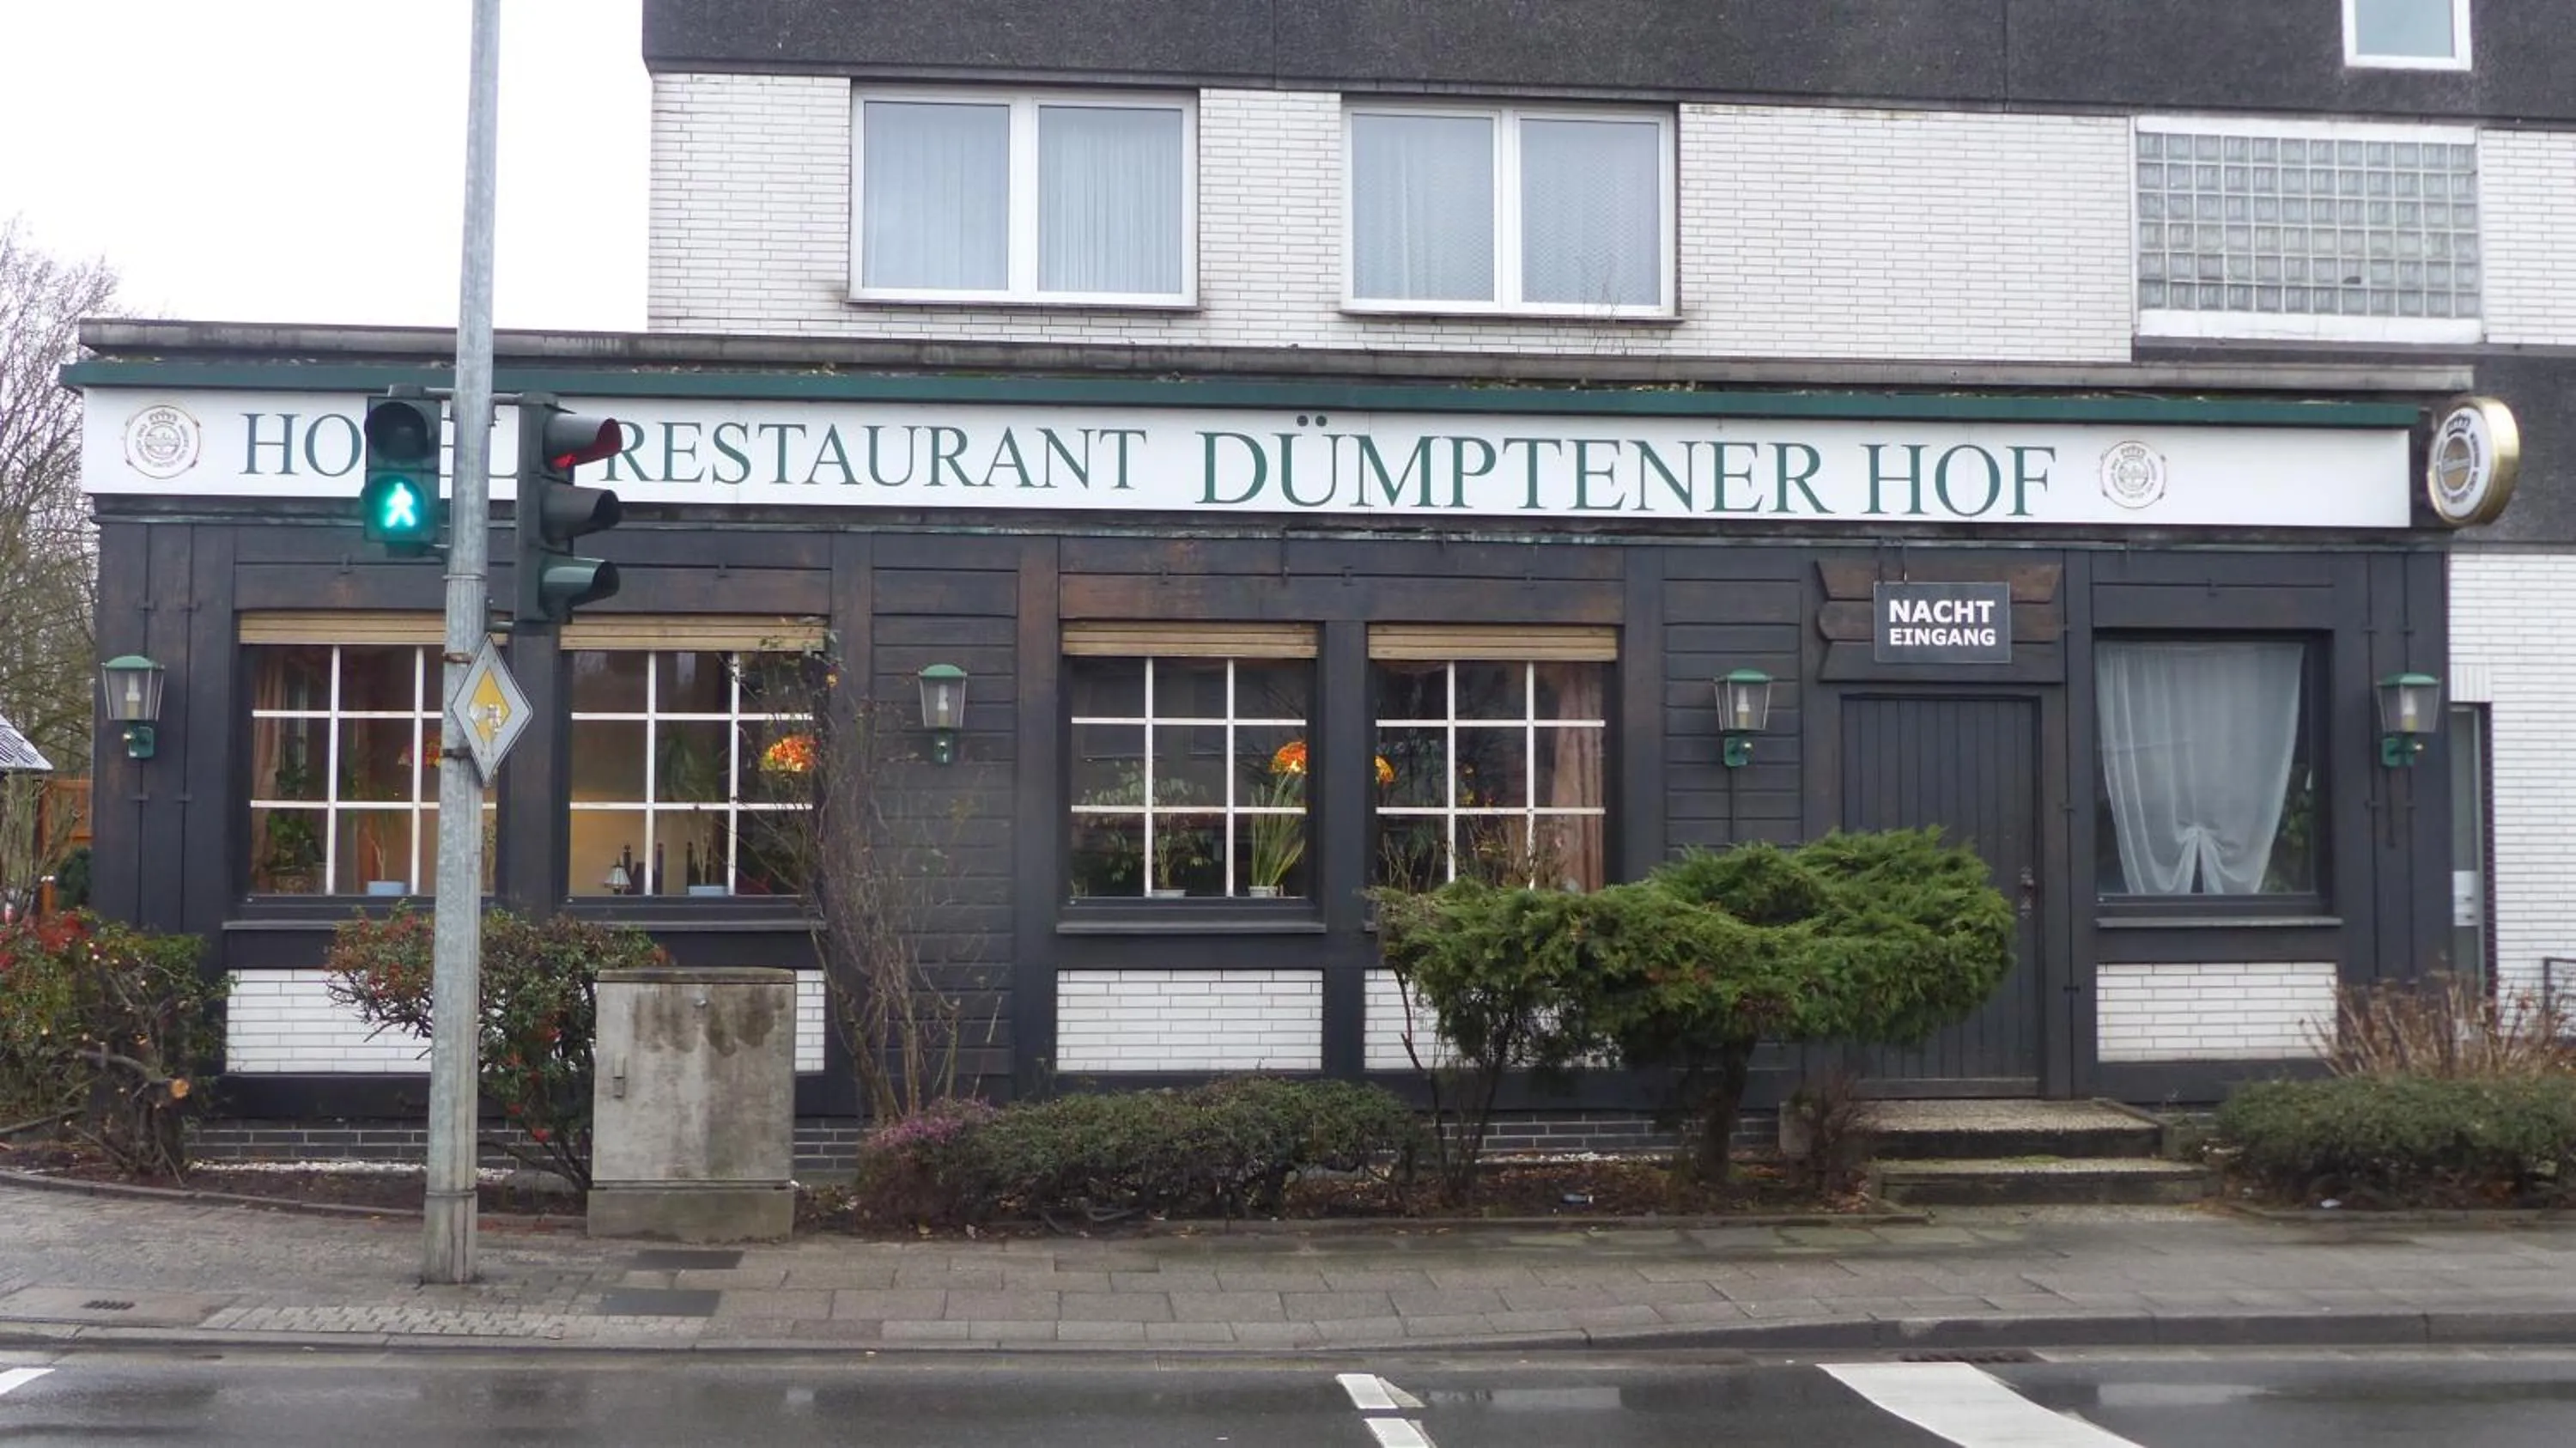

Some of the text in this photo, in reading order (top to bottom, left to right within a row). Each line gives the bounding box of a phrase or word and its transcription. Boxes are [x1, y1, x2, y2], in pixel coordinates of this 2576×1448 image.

[599, 420, 1146, 490] RESTAURANT
[1194, 414, 1836, 514] DÜMPTENER
[1858, 442, 2057, 517] HOF
[1889, 599, 1995, 623] NACHT
[1889, 628, 1996, 646] EINGANG
